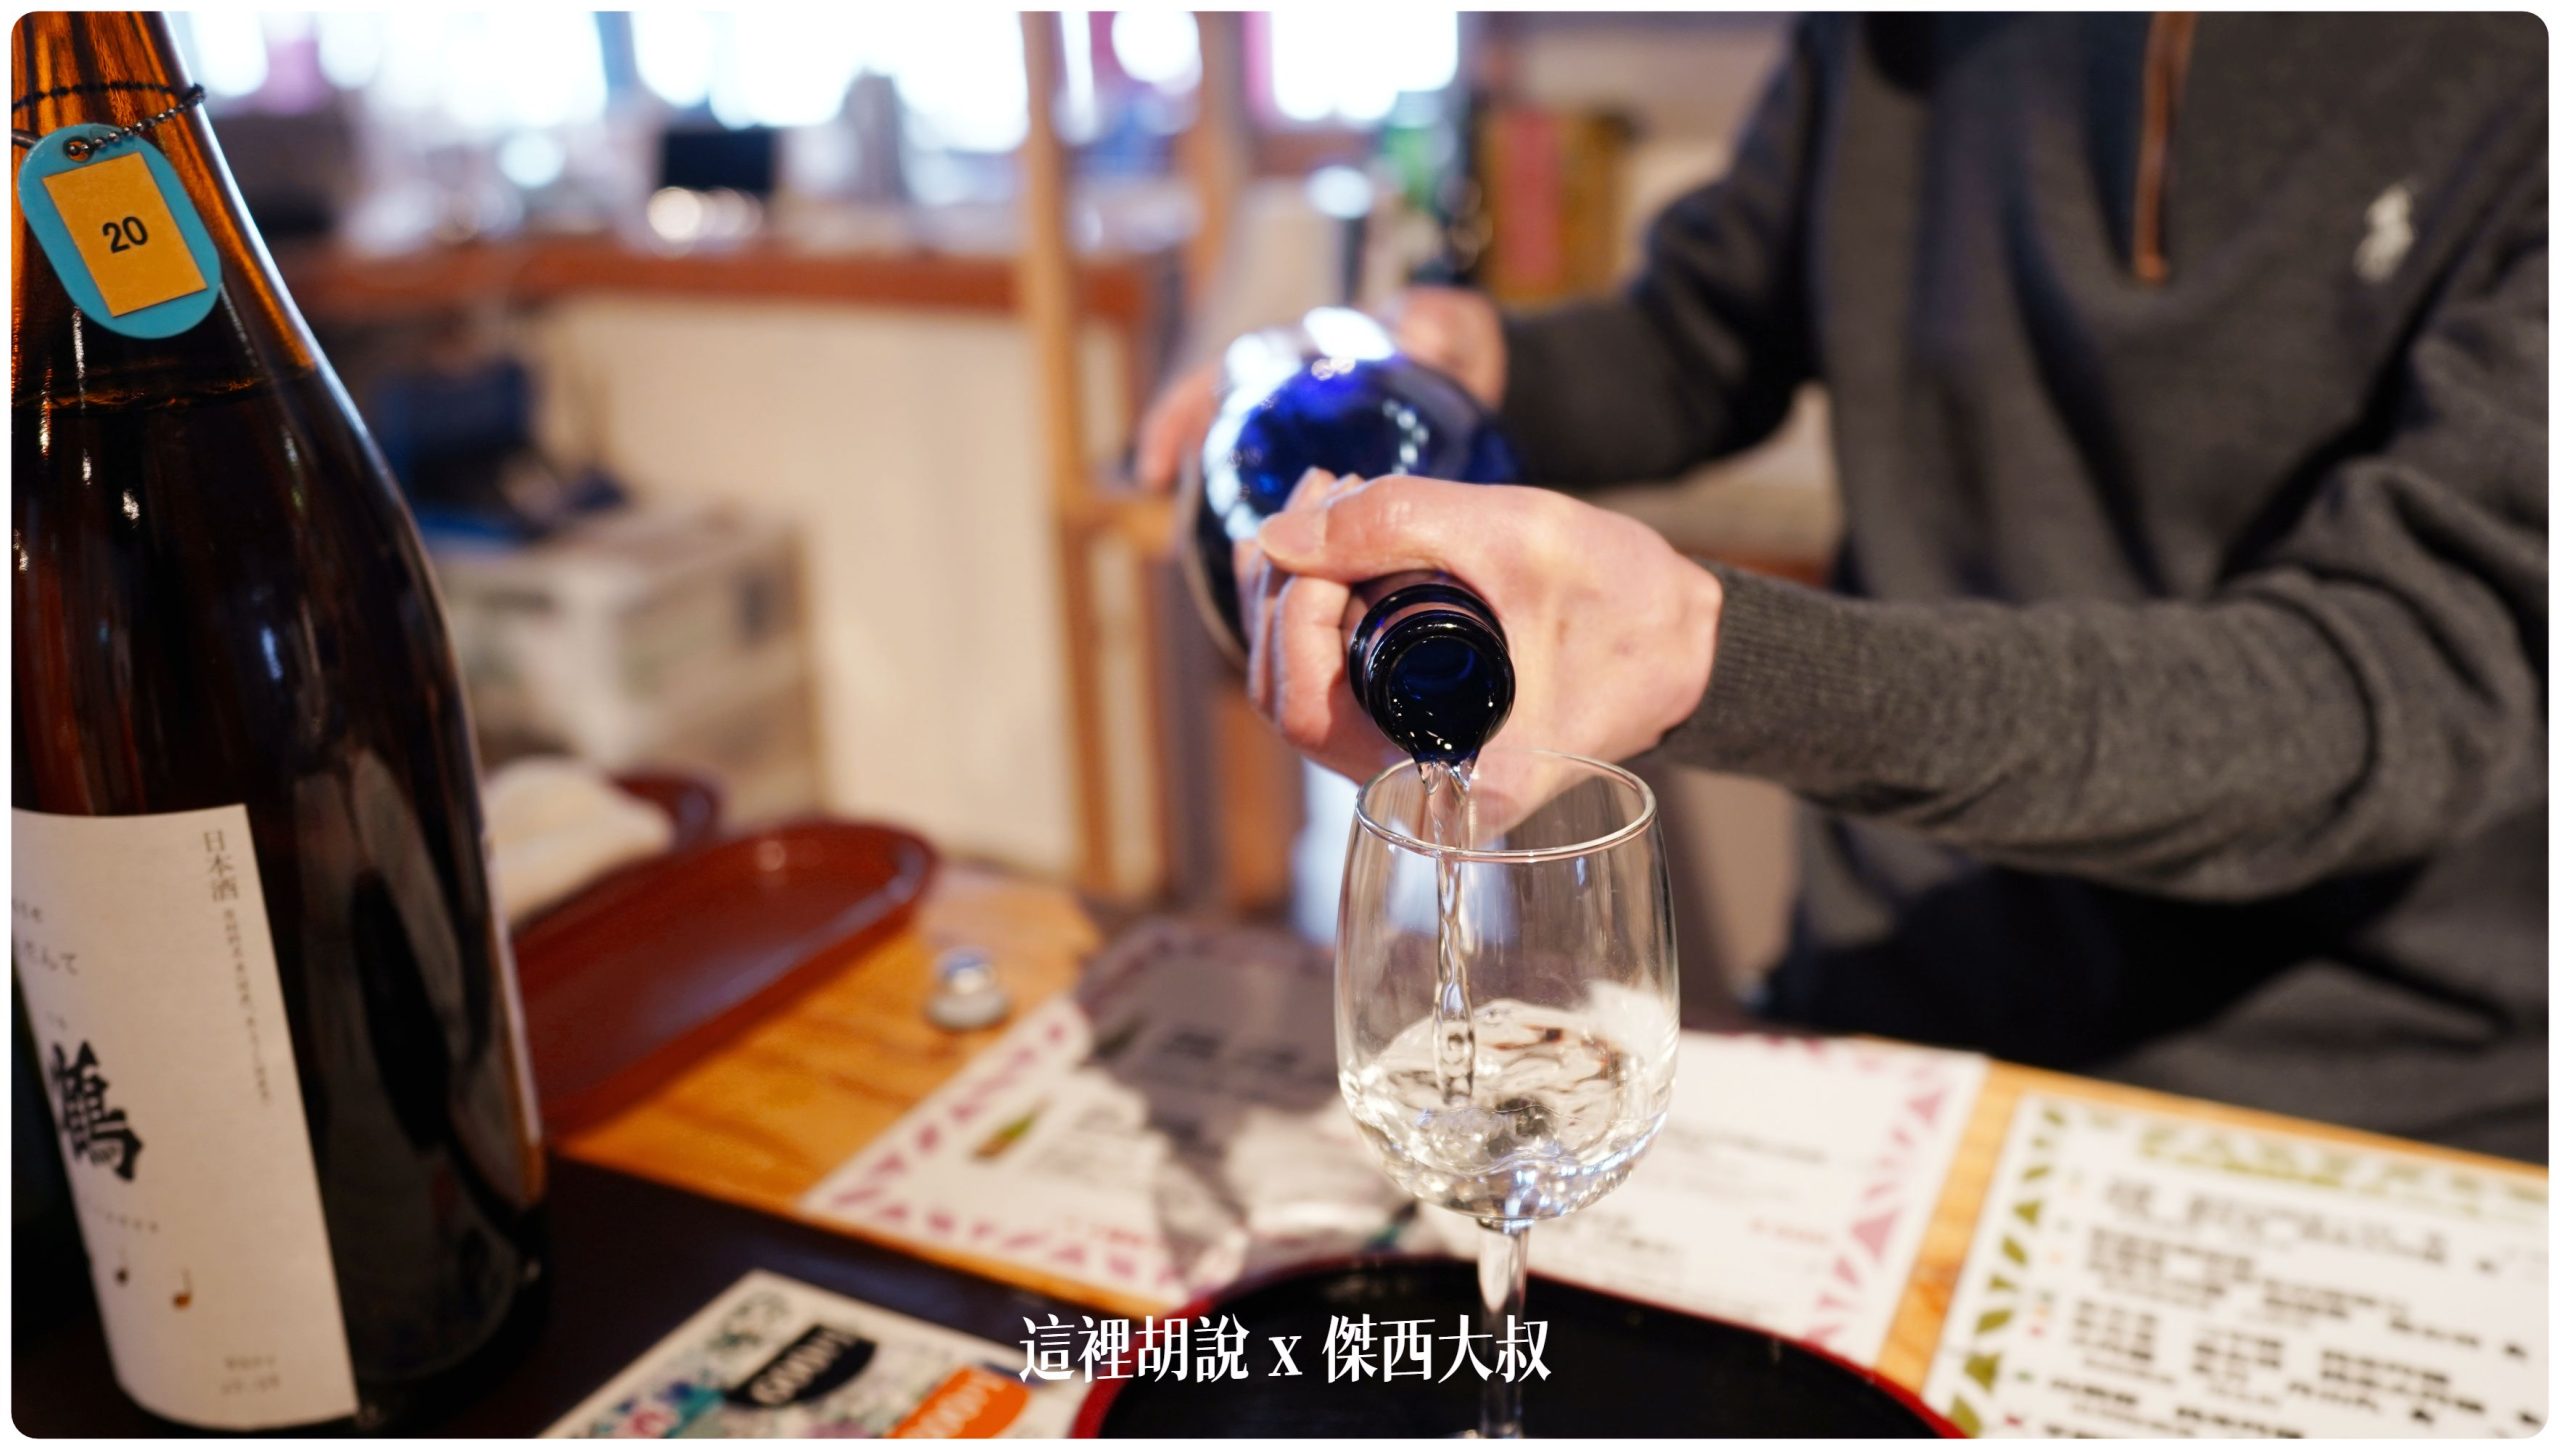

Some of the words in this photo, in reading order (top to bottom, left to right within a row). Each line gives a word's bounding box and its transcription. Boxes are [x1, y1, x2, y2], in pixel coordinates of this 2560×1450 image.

[102, 216, 149, 254] 20
[203, 829, 239, 902] 日本酒
